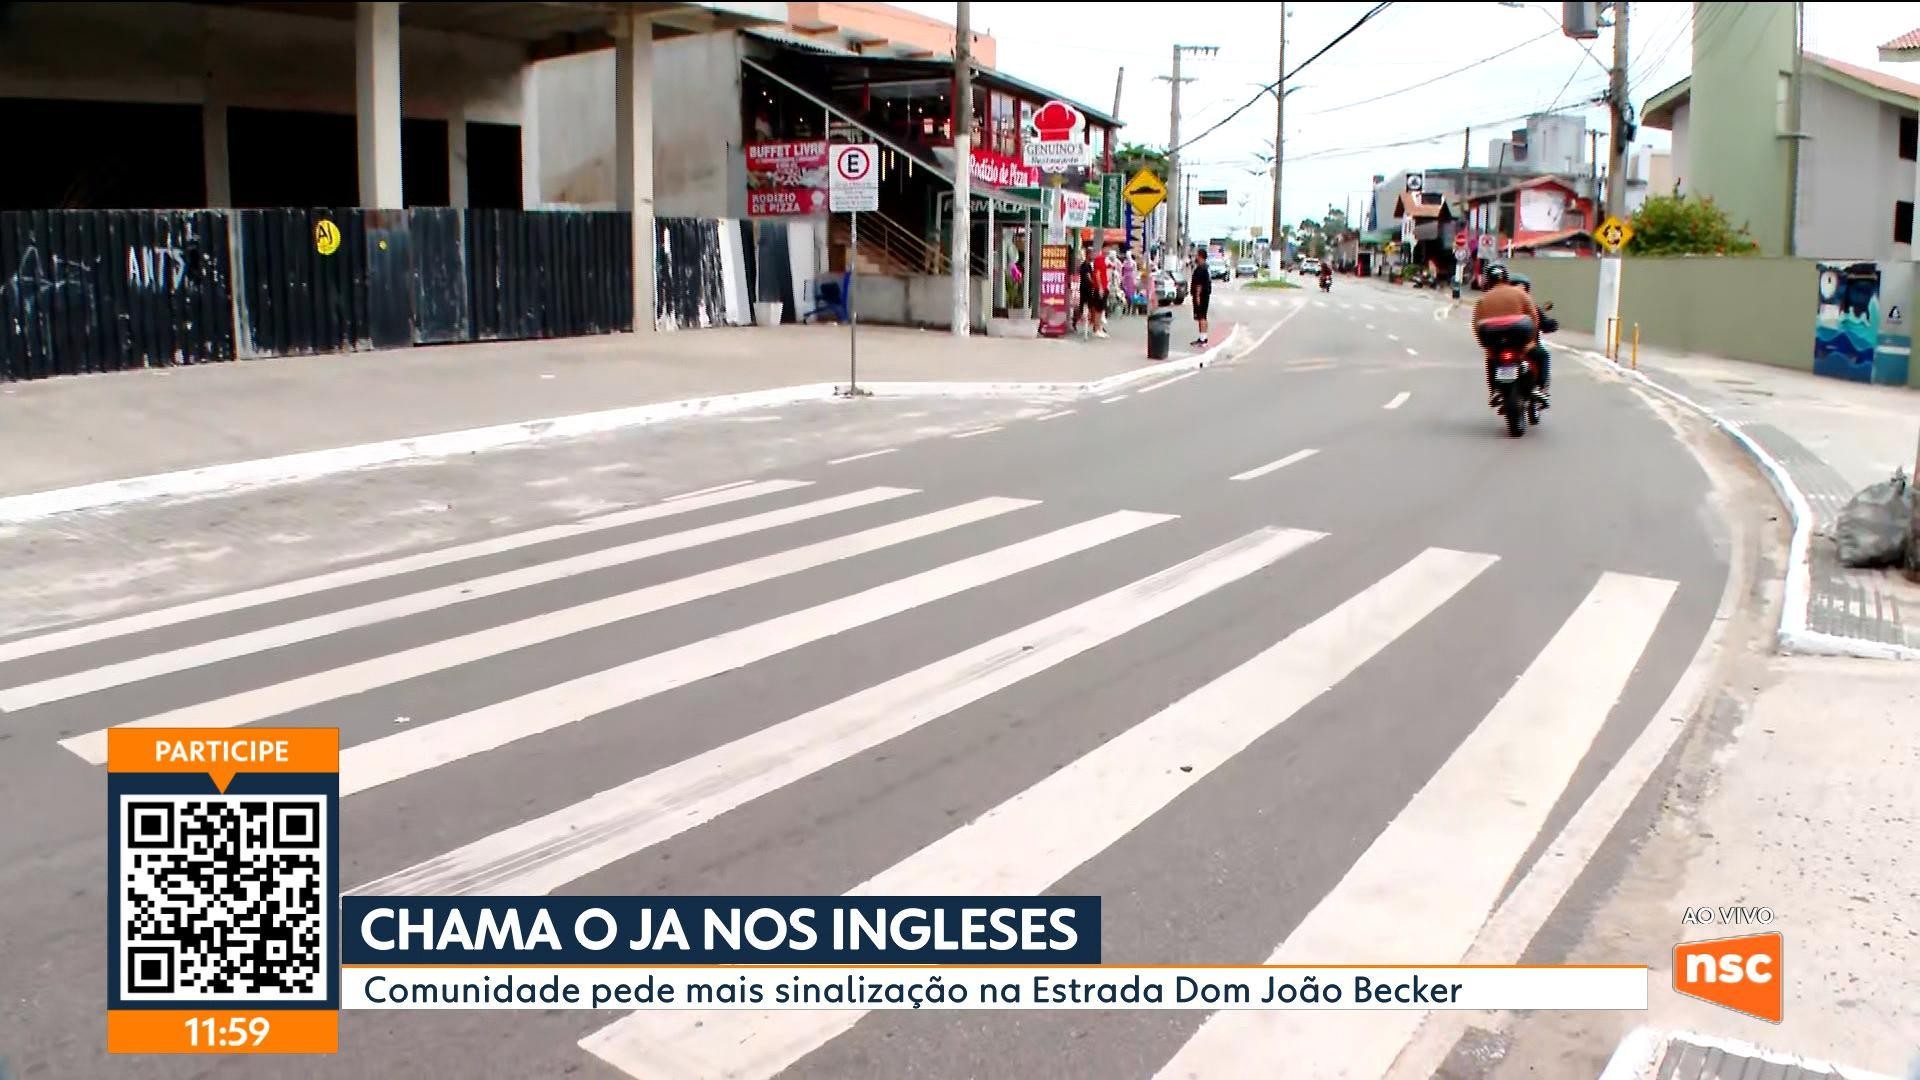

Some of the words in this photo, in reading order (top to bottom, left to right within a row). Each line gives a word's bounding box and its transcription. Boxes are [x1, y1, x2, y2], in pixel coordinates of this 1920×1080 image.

[748, 145, 791, 158] BUFFET
[794, 141, 826, 156] LIVRE
[847, 154, 859, 173] E
[999, 162, 1010, 185] de
[752, 203, 766, 214] DE
[769, 202, 801, 214] PIZZA
